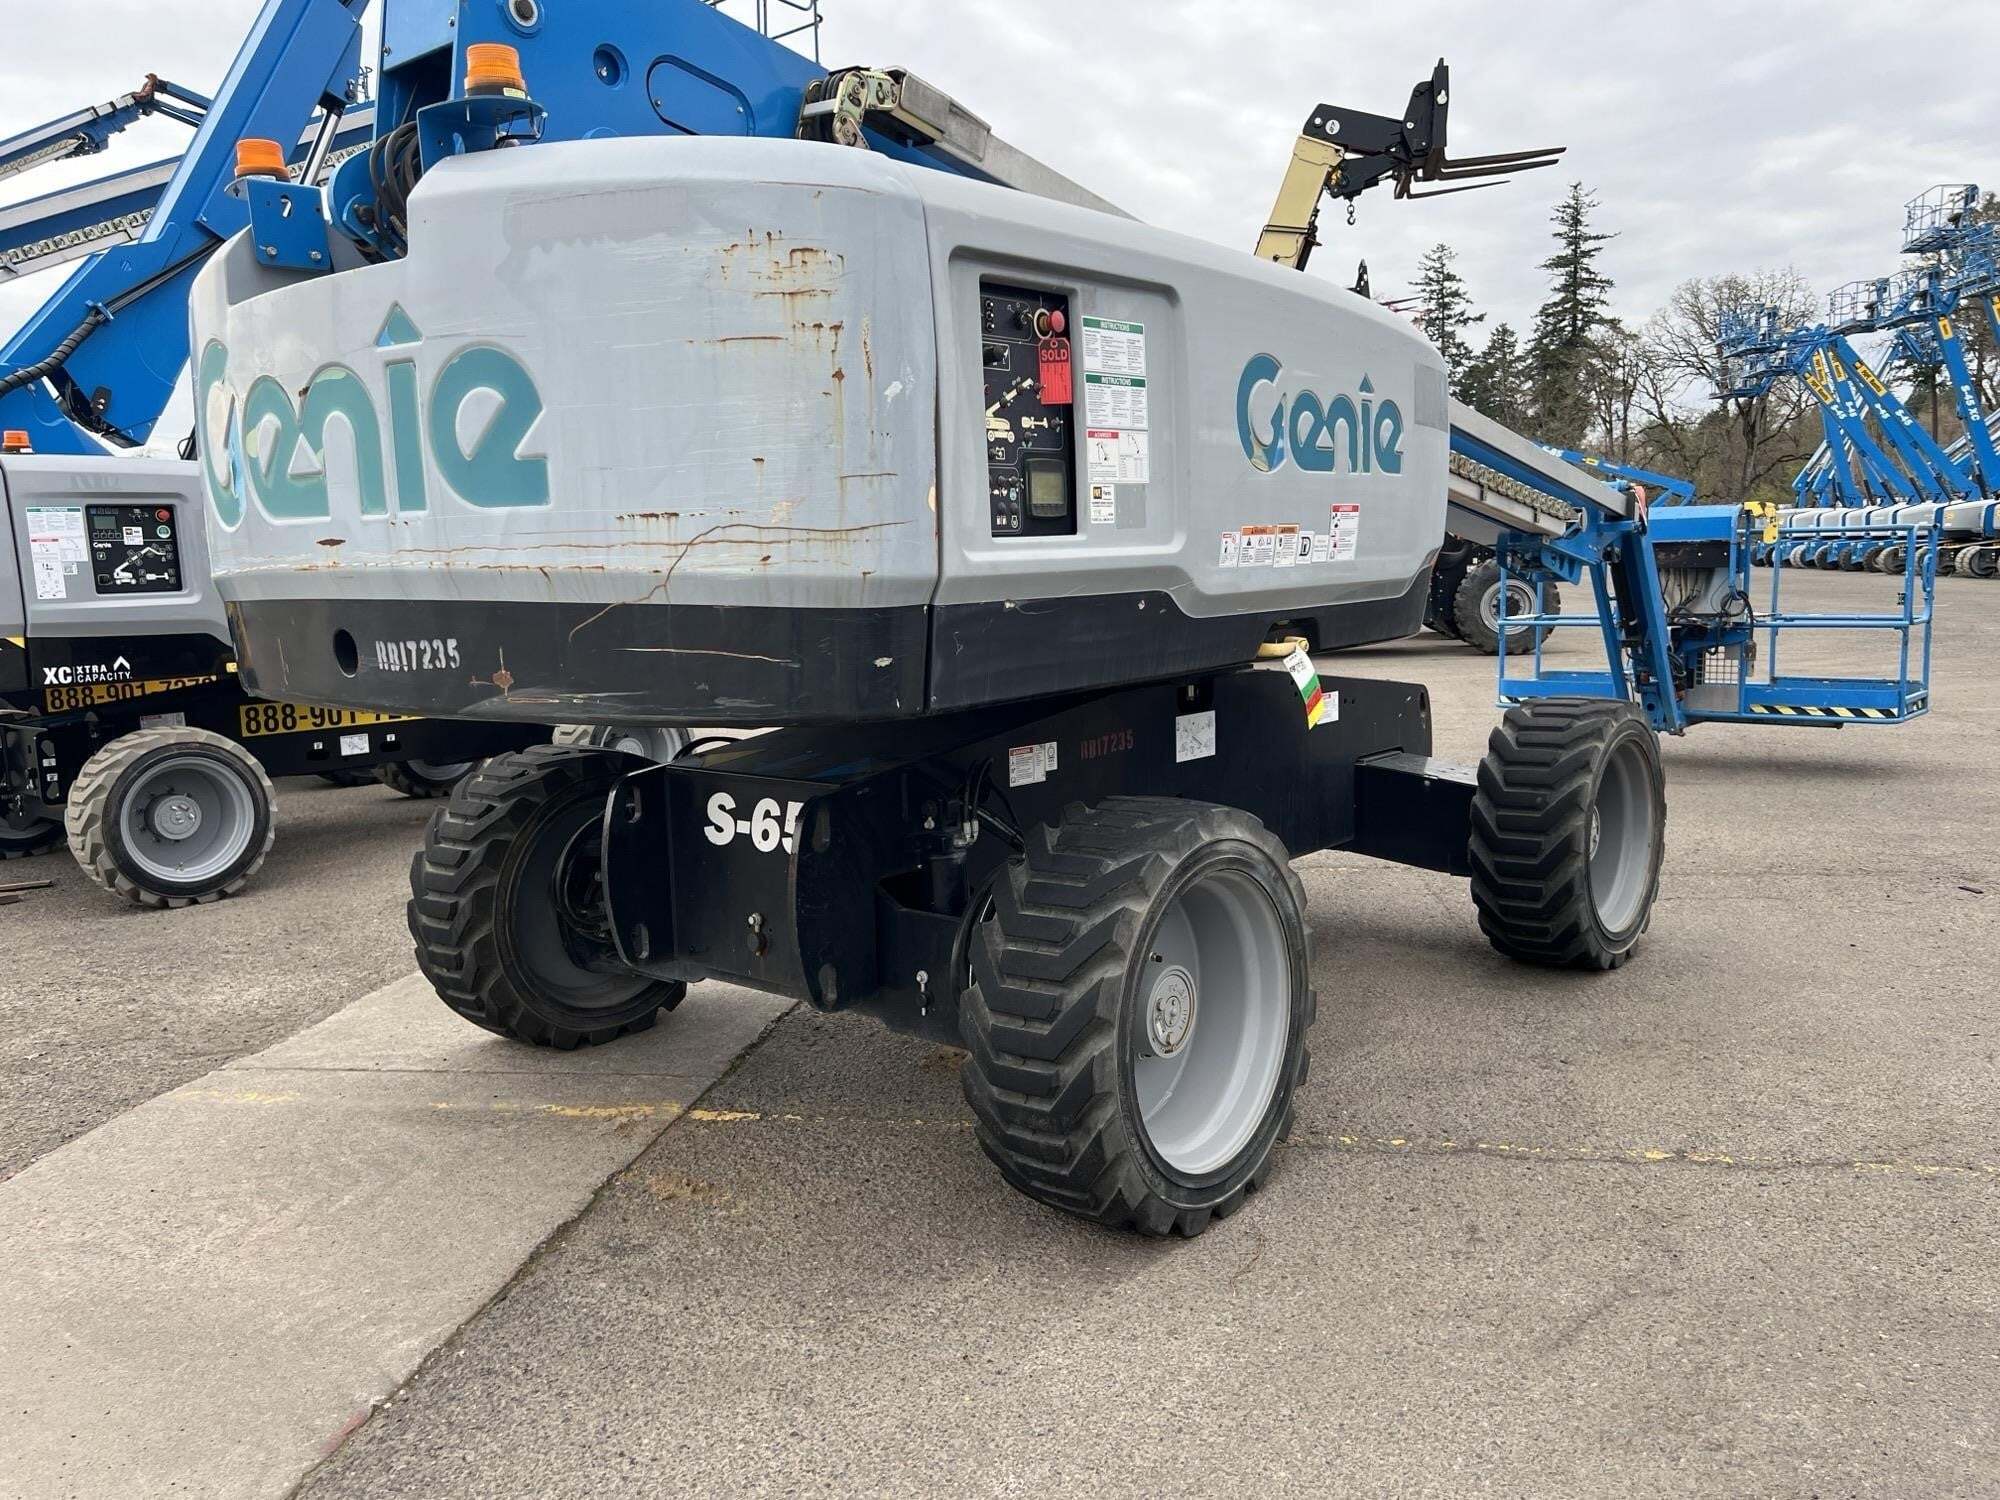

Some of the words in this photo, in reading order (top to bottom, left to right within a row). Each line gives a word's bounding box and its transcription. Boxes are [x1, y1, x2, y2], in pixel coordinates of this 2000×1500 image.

[1041, 349, 1068, 361] SOLD
[200, 300, 553, 533] Genie
[1237, 352, 1405, 475] Genie
[1968, 408, 1980, 421] XC
[43, 666, 73, 685] XC
[76, 664, 108, 675] XTRA
[77, 671, 131, 683] CAPACITY
